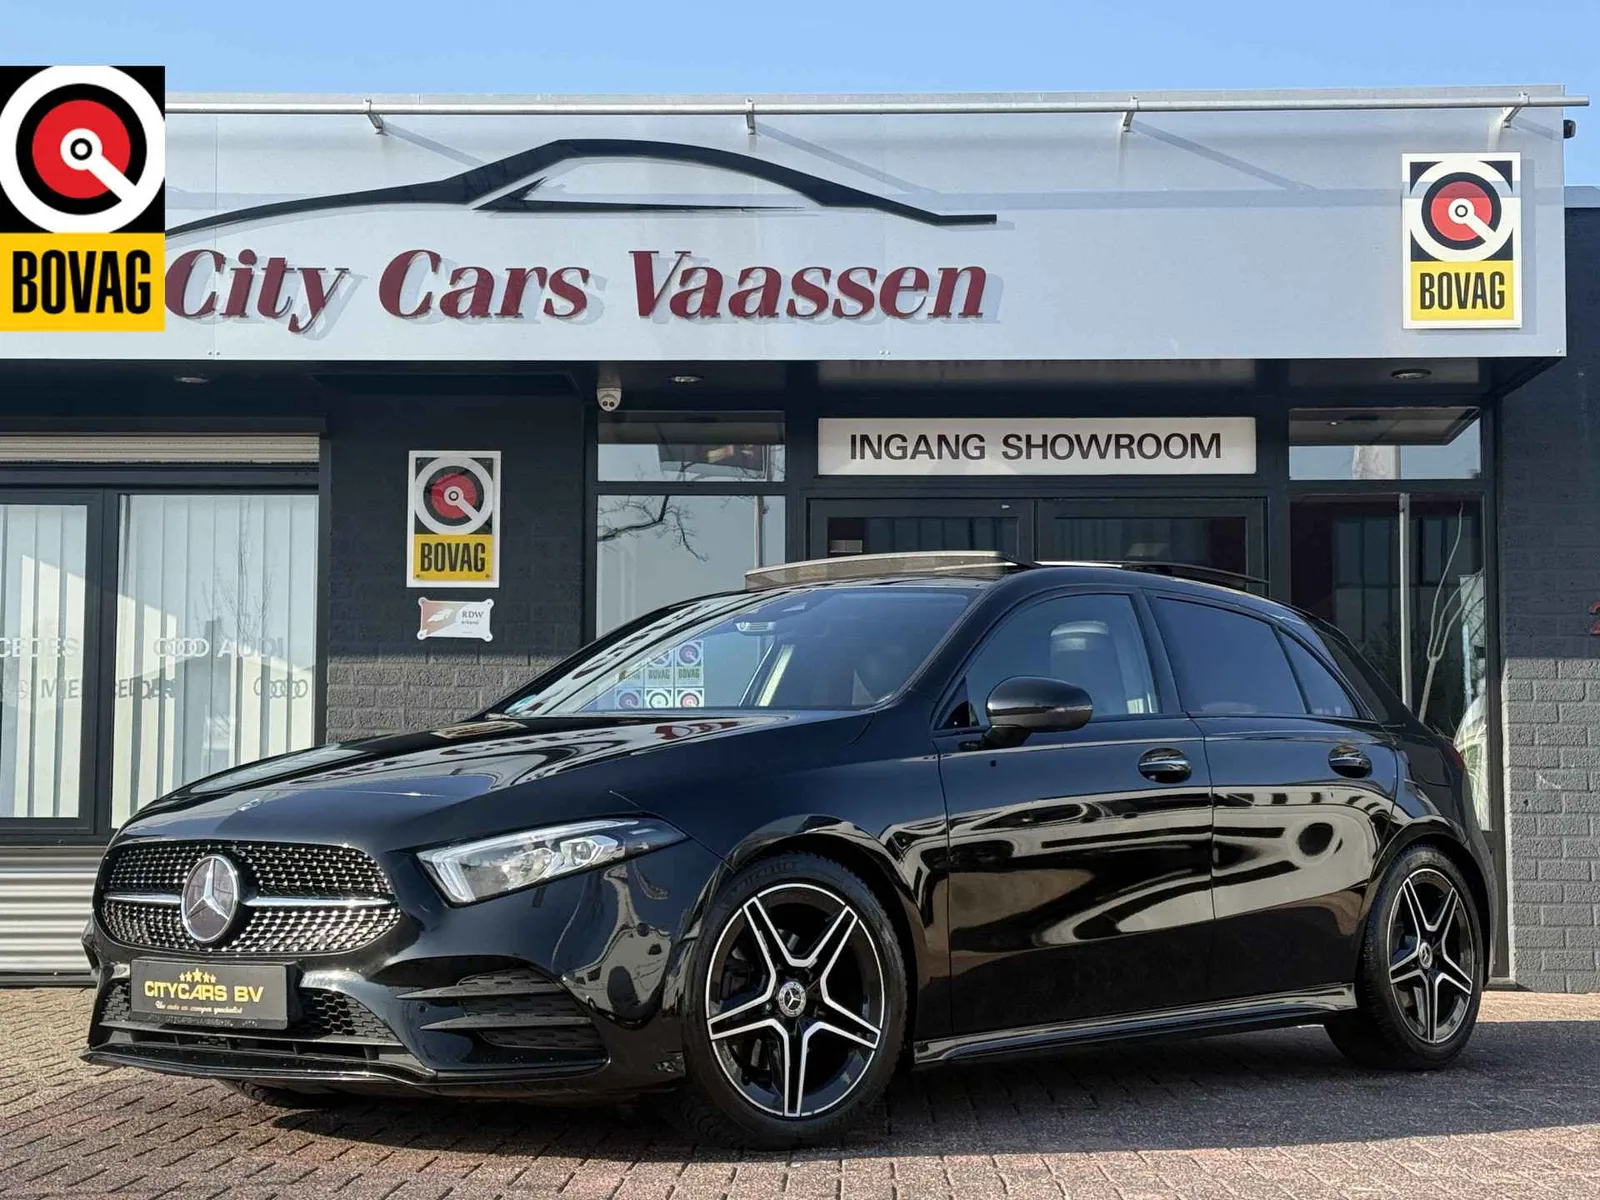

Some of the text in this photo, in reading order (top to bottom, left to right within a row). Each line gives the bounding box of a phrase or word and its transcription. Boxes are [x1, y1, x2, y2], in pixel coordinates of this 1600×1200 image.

[165, 249, 988, 333] City Cars Vaassen
[1419, 271, 1505, 310] BOVAG
[850, 432, 1221, 460] INGANG SHOWROOM
[420, 542, 486, 573] BOVAG
[217, 637, 285, 658] AUDI
[144, 980, 264, 1003] CITYCARS BV
